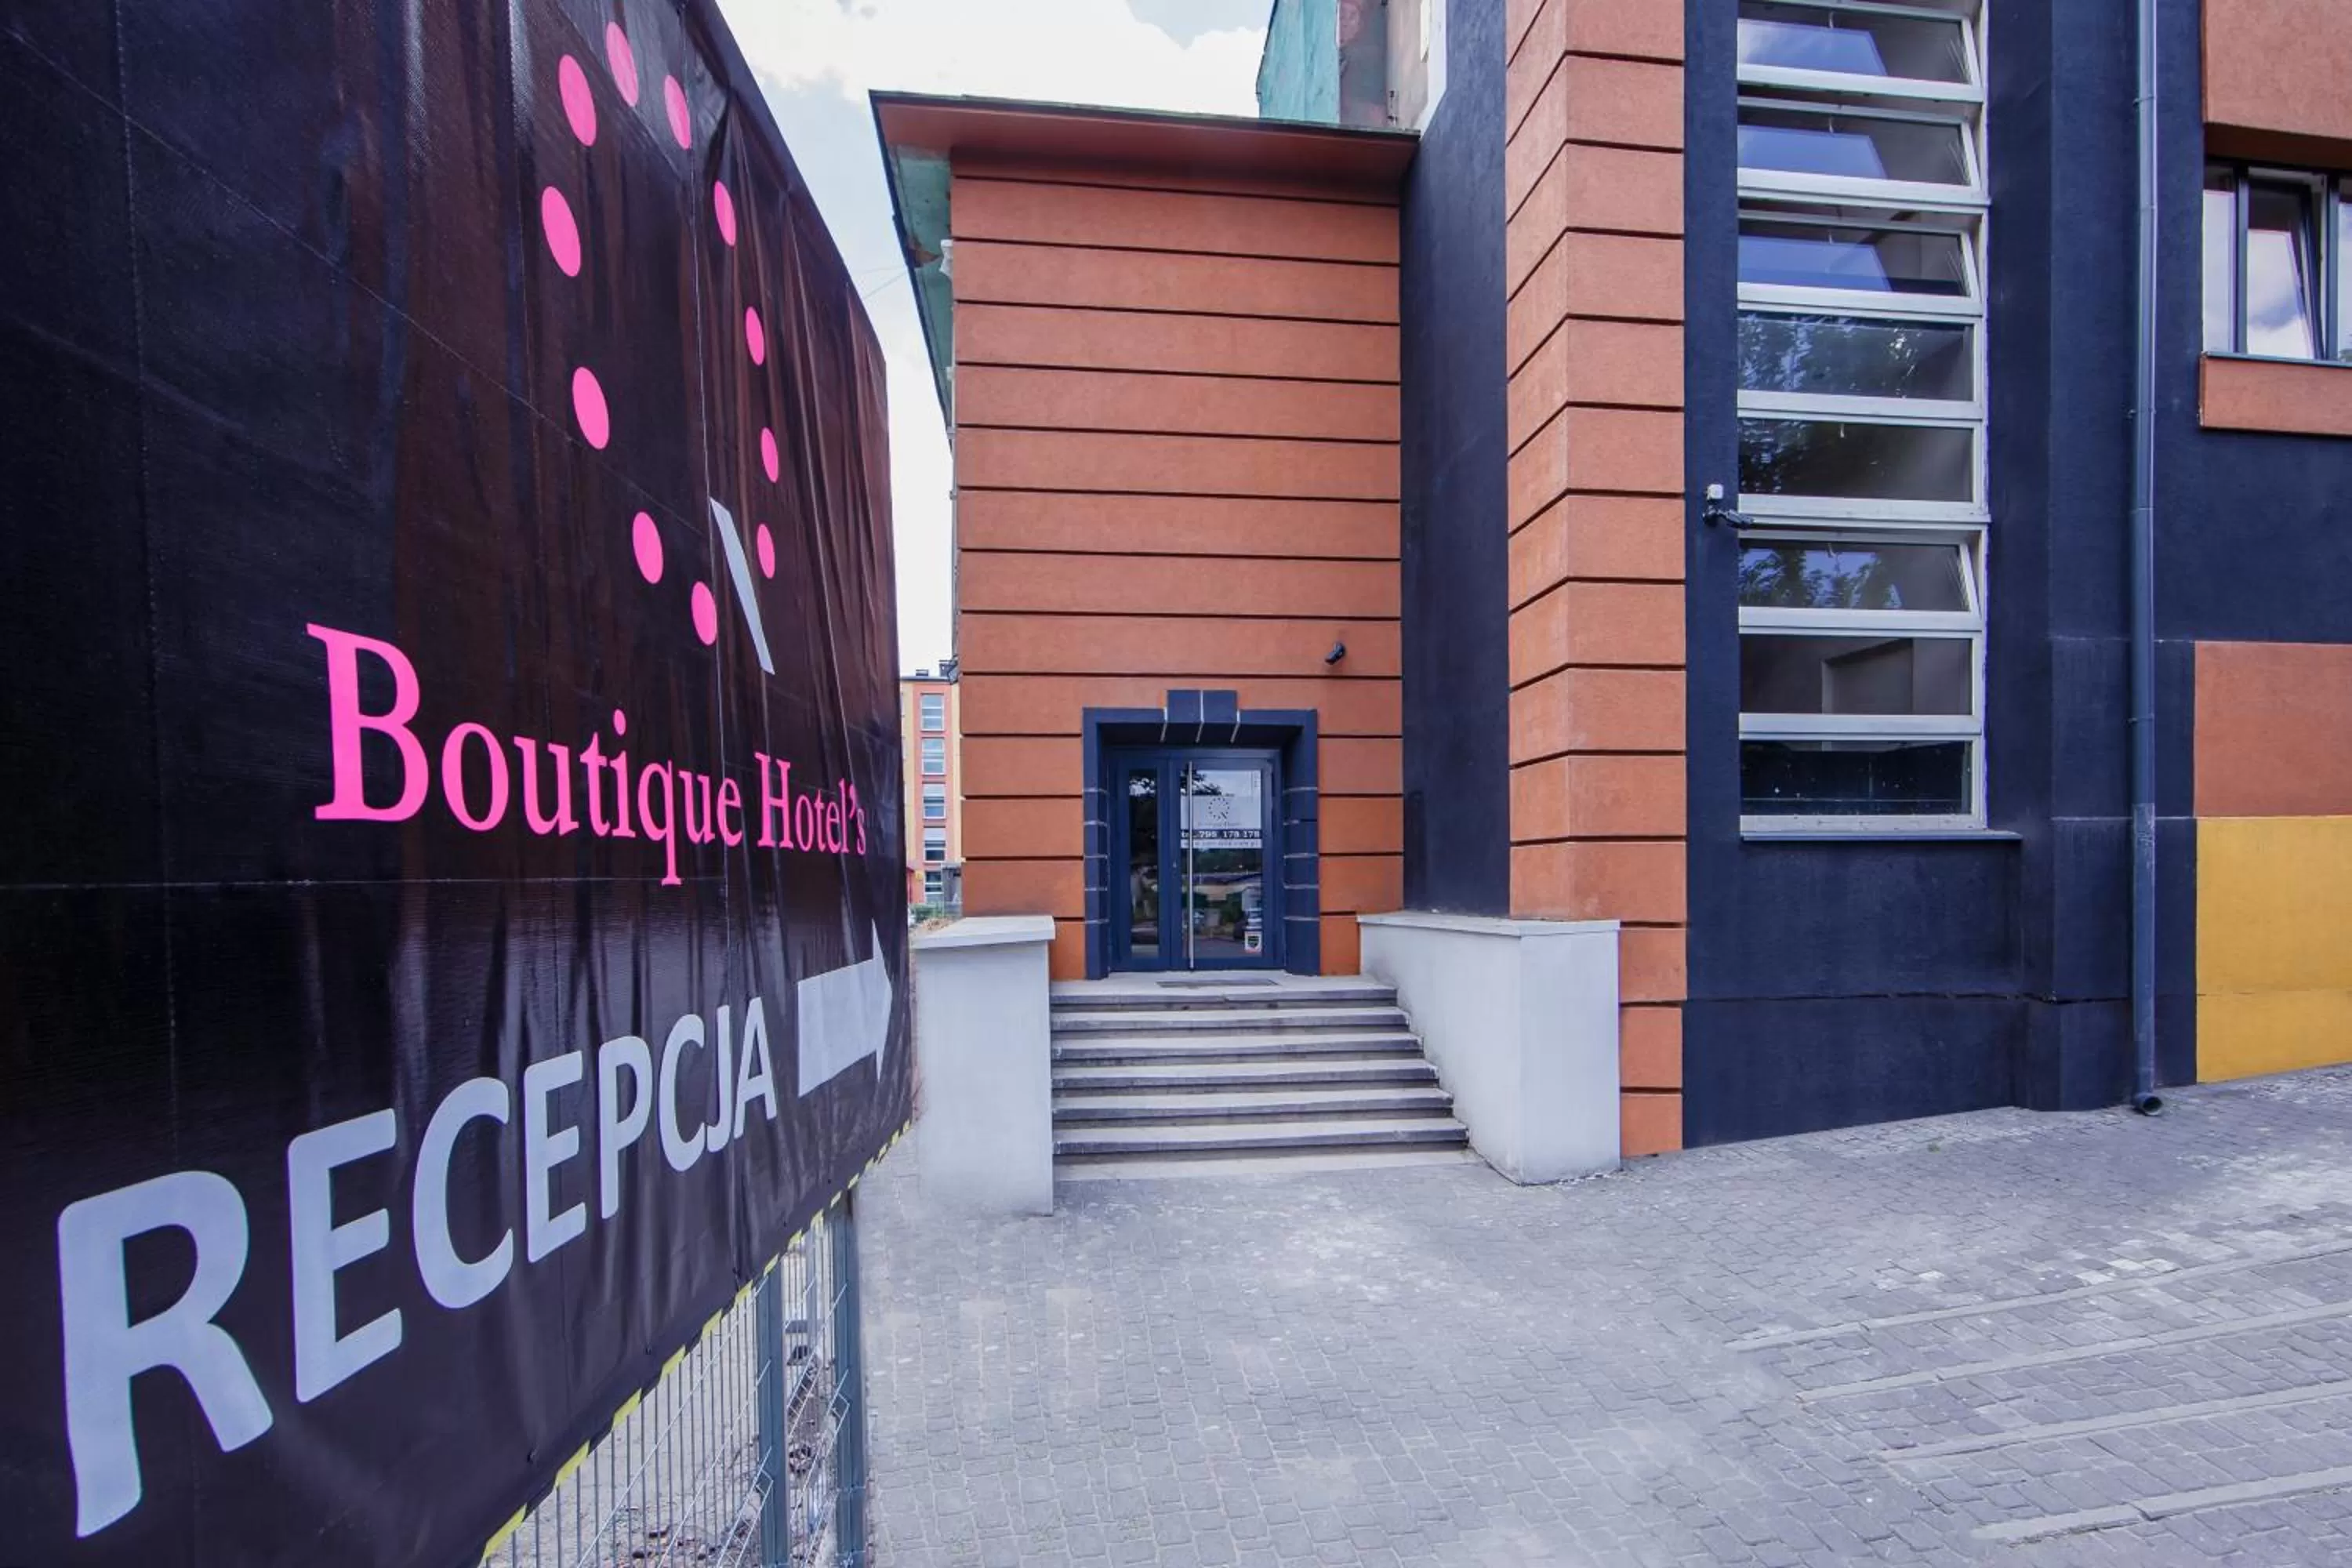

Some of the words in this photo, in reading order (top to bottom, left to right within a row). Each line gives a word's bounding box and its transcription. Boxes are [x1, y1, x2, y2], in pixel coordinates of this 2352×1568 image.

[306, 622, 743, 886] Boutique
[754, 751, 866, 855] Hotel's
[58, 996, 777, 1538] RECEPCJA
